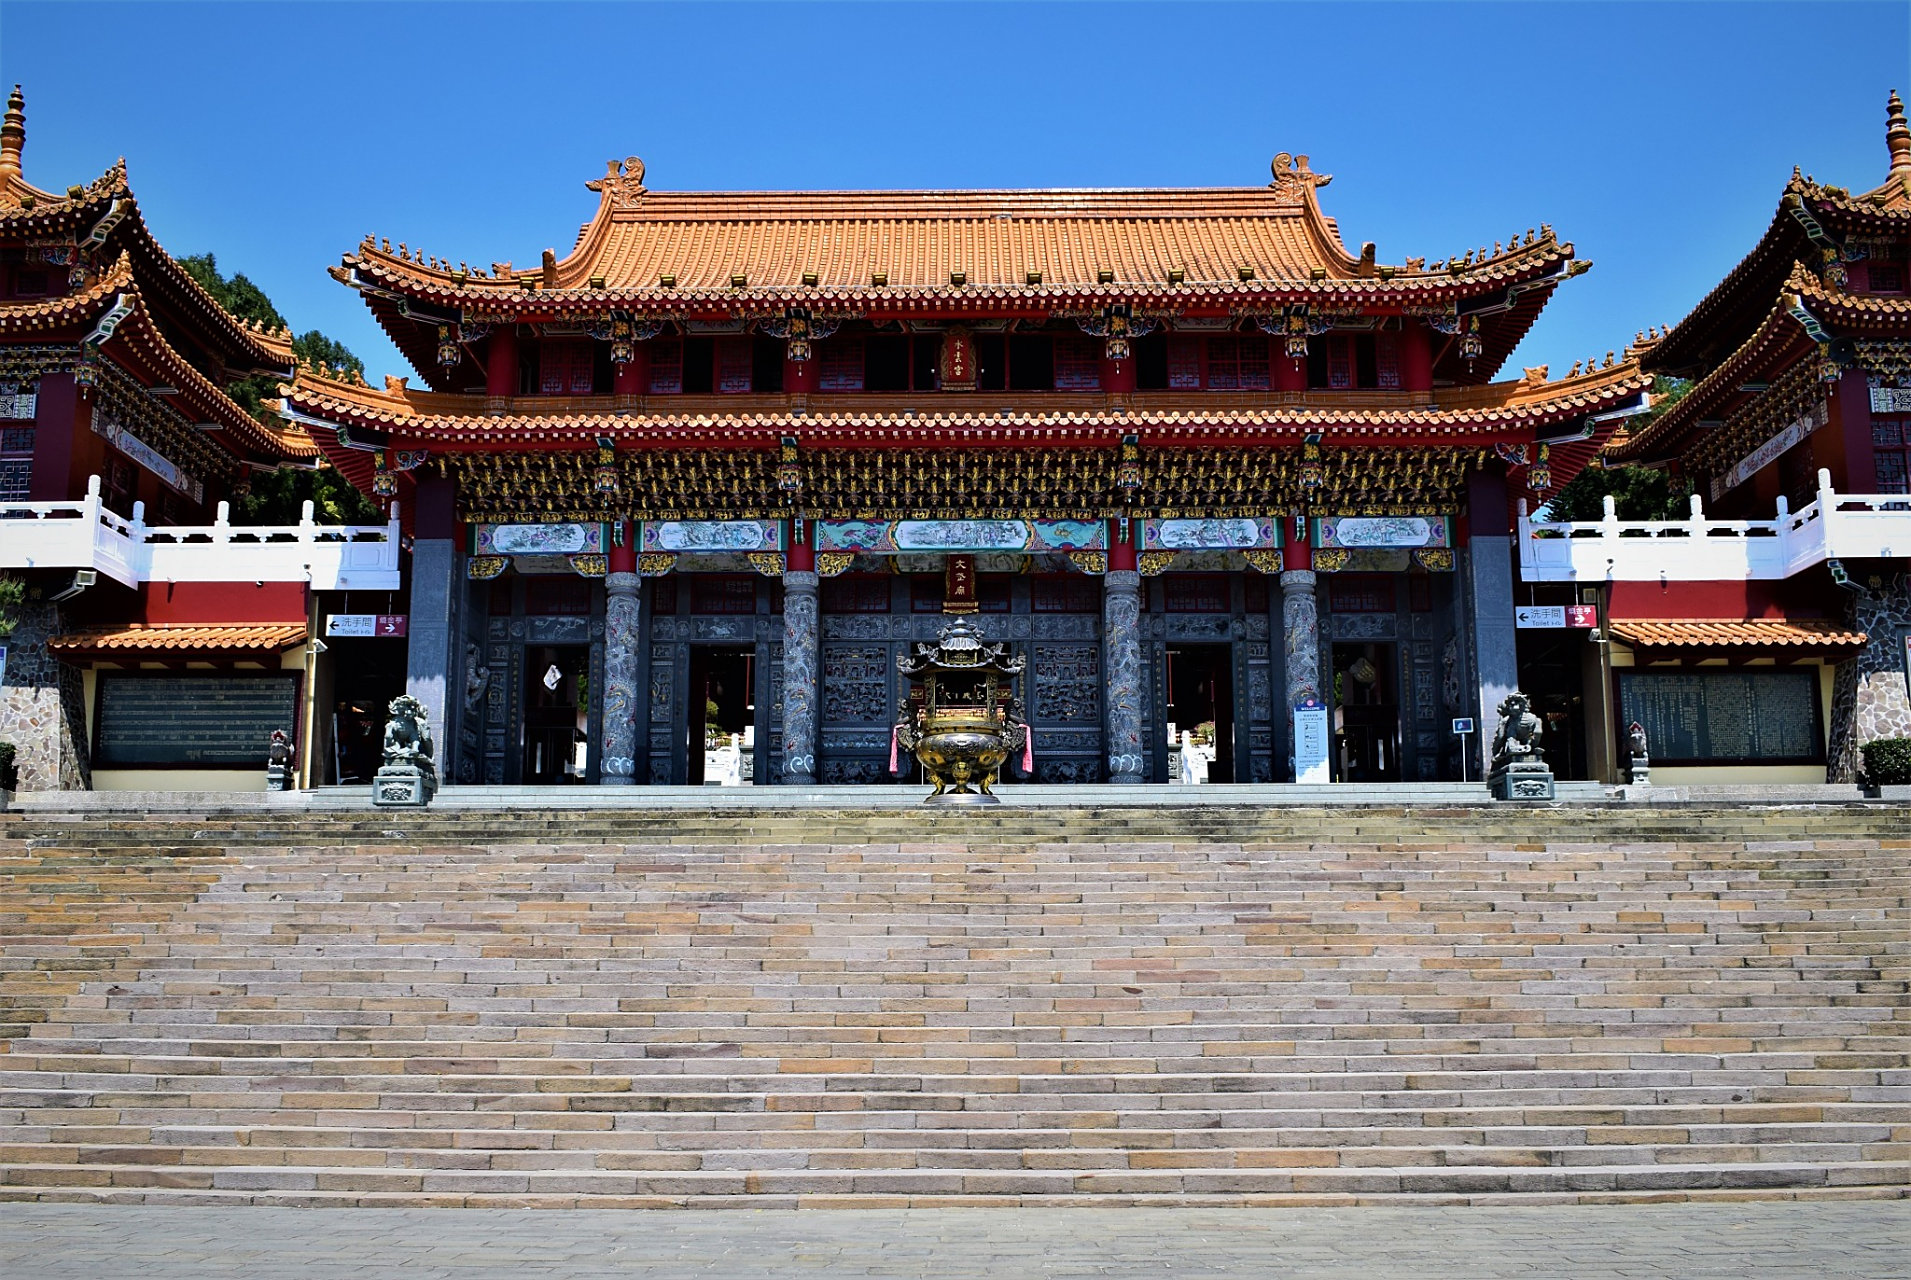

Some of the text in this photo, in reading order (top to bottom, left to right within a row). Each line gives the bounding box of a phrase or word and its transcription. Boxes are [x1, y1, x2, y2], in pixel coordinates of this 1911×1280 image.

[1530, 607, 1562, 619] 洗手間
[341, 616, 373, 628] 洗手間
